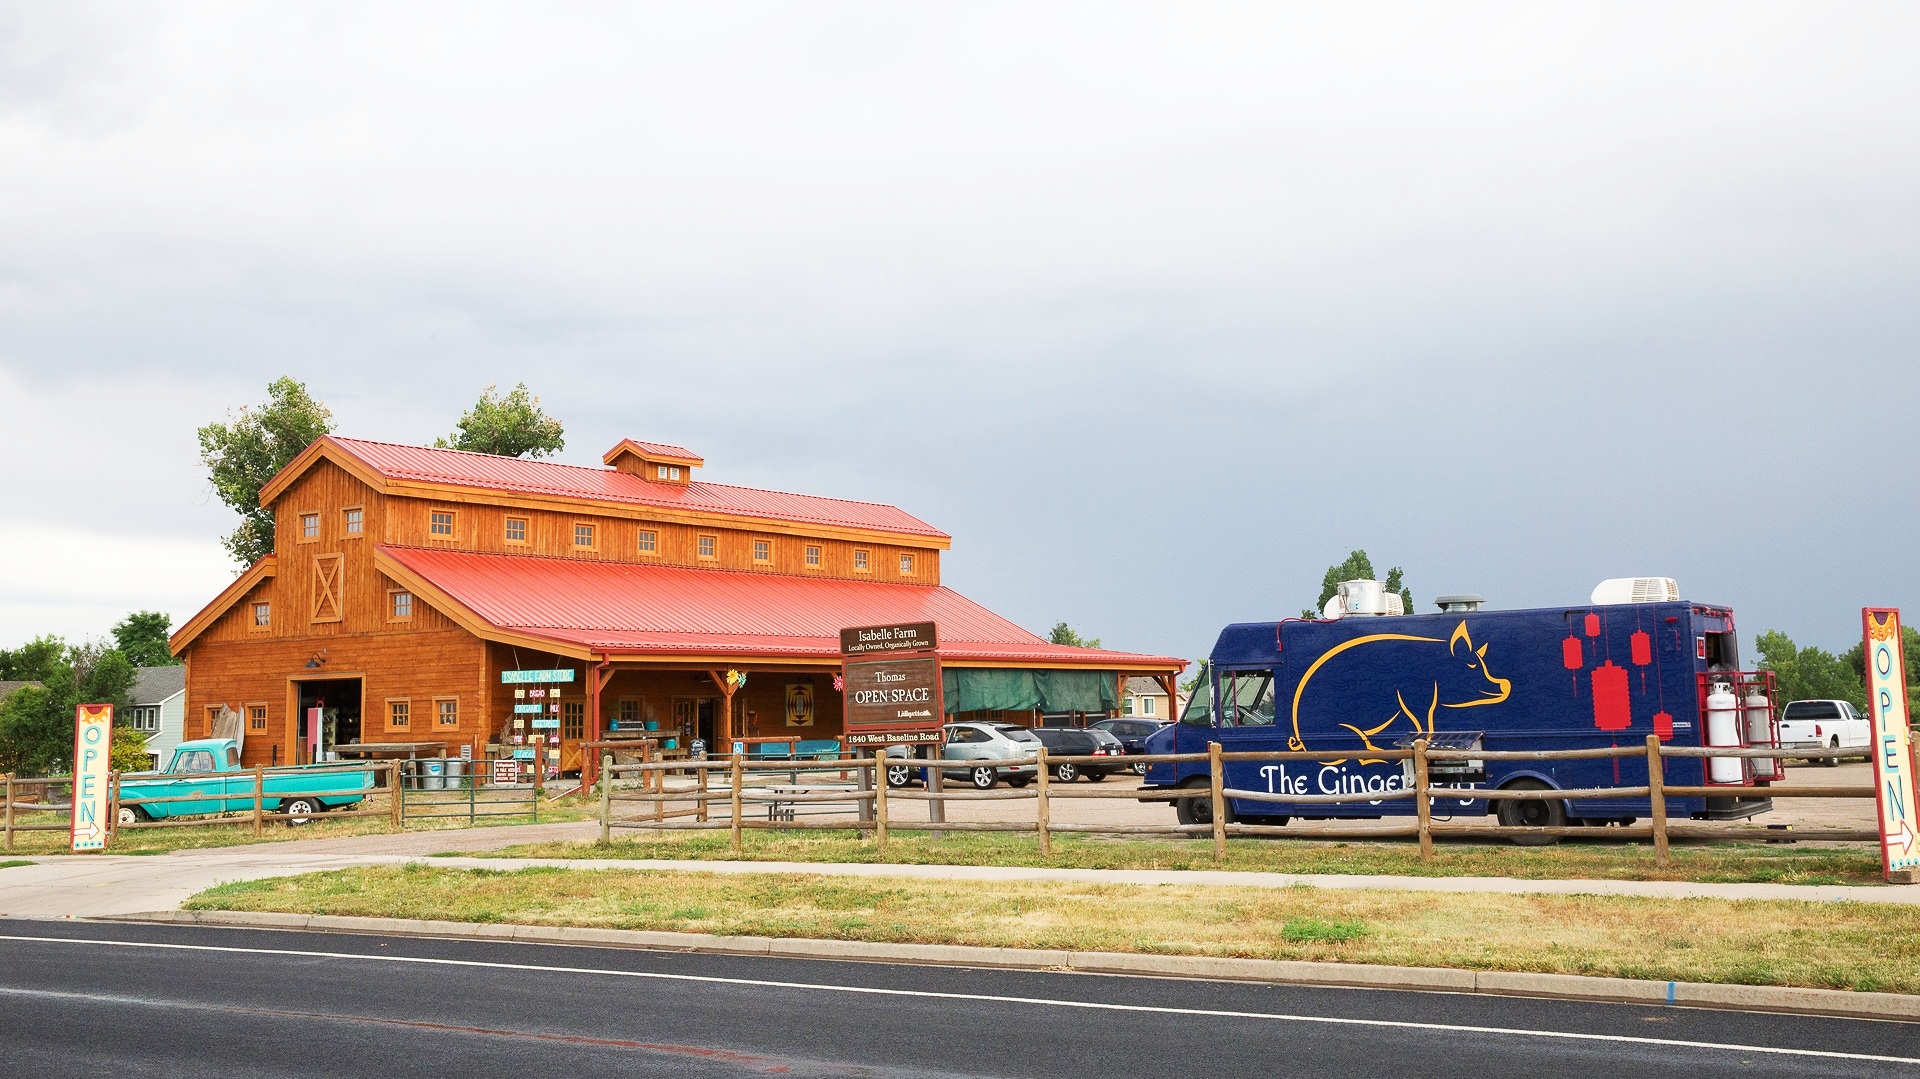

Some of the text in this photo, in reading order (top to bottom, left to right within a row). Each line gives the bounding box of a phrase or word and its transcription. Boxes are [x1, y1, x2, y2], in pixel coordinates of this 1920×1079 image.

[858, 627, 917, 641] Isabelle Farm
[848, 639, 929, 652] Locally Owned, Organically Grown
[874, 671, 906, 683] Thomas
[855, 687, 930, 704] OPEN SPACE
[867, 734, 885, 743] West
[886, 733, 918, 742] Baseline
[919, 732, 940, 741] Road
[1874, 642, 1906, 822] OPEN
[79, 725, 102, 822] OPEN
[1259, 764, 1308, 795] The
